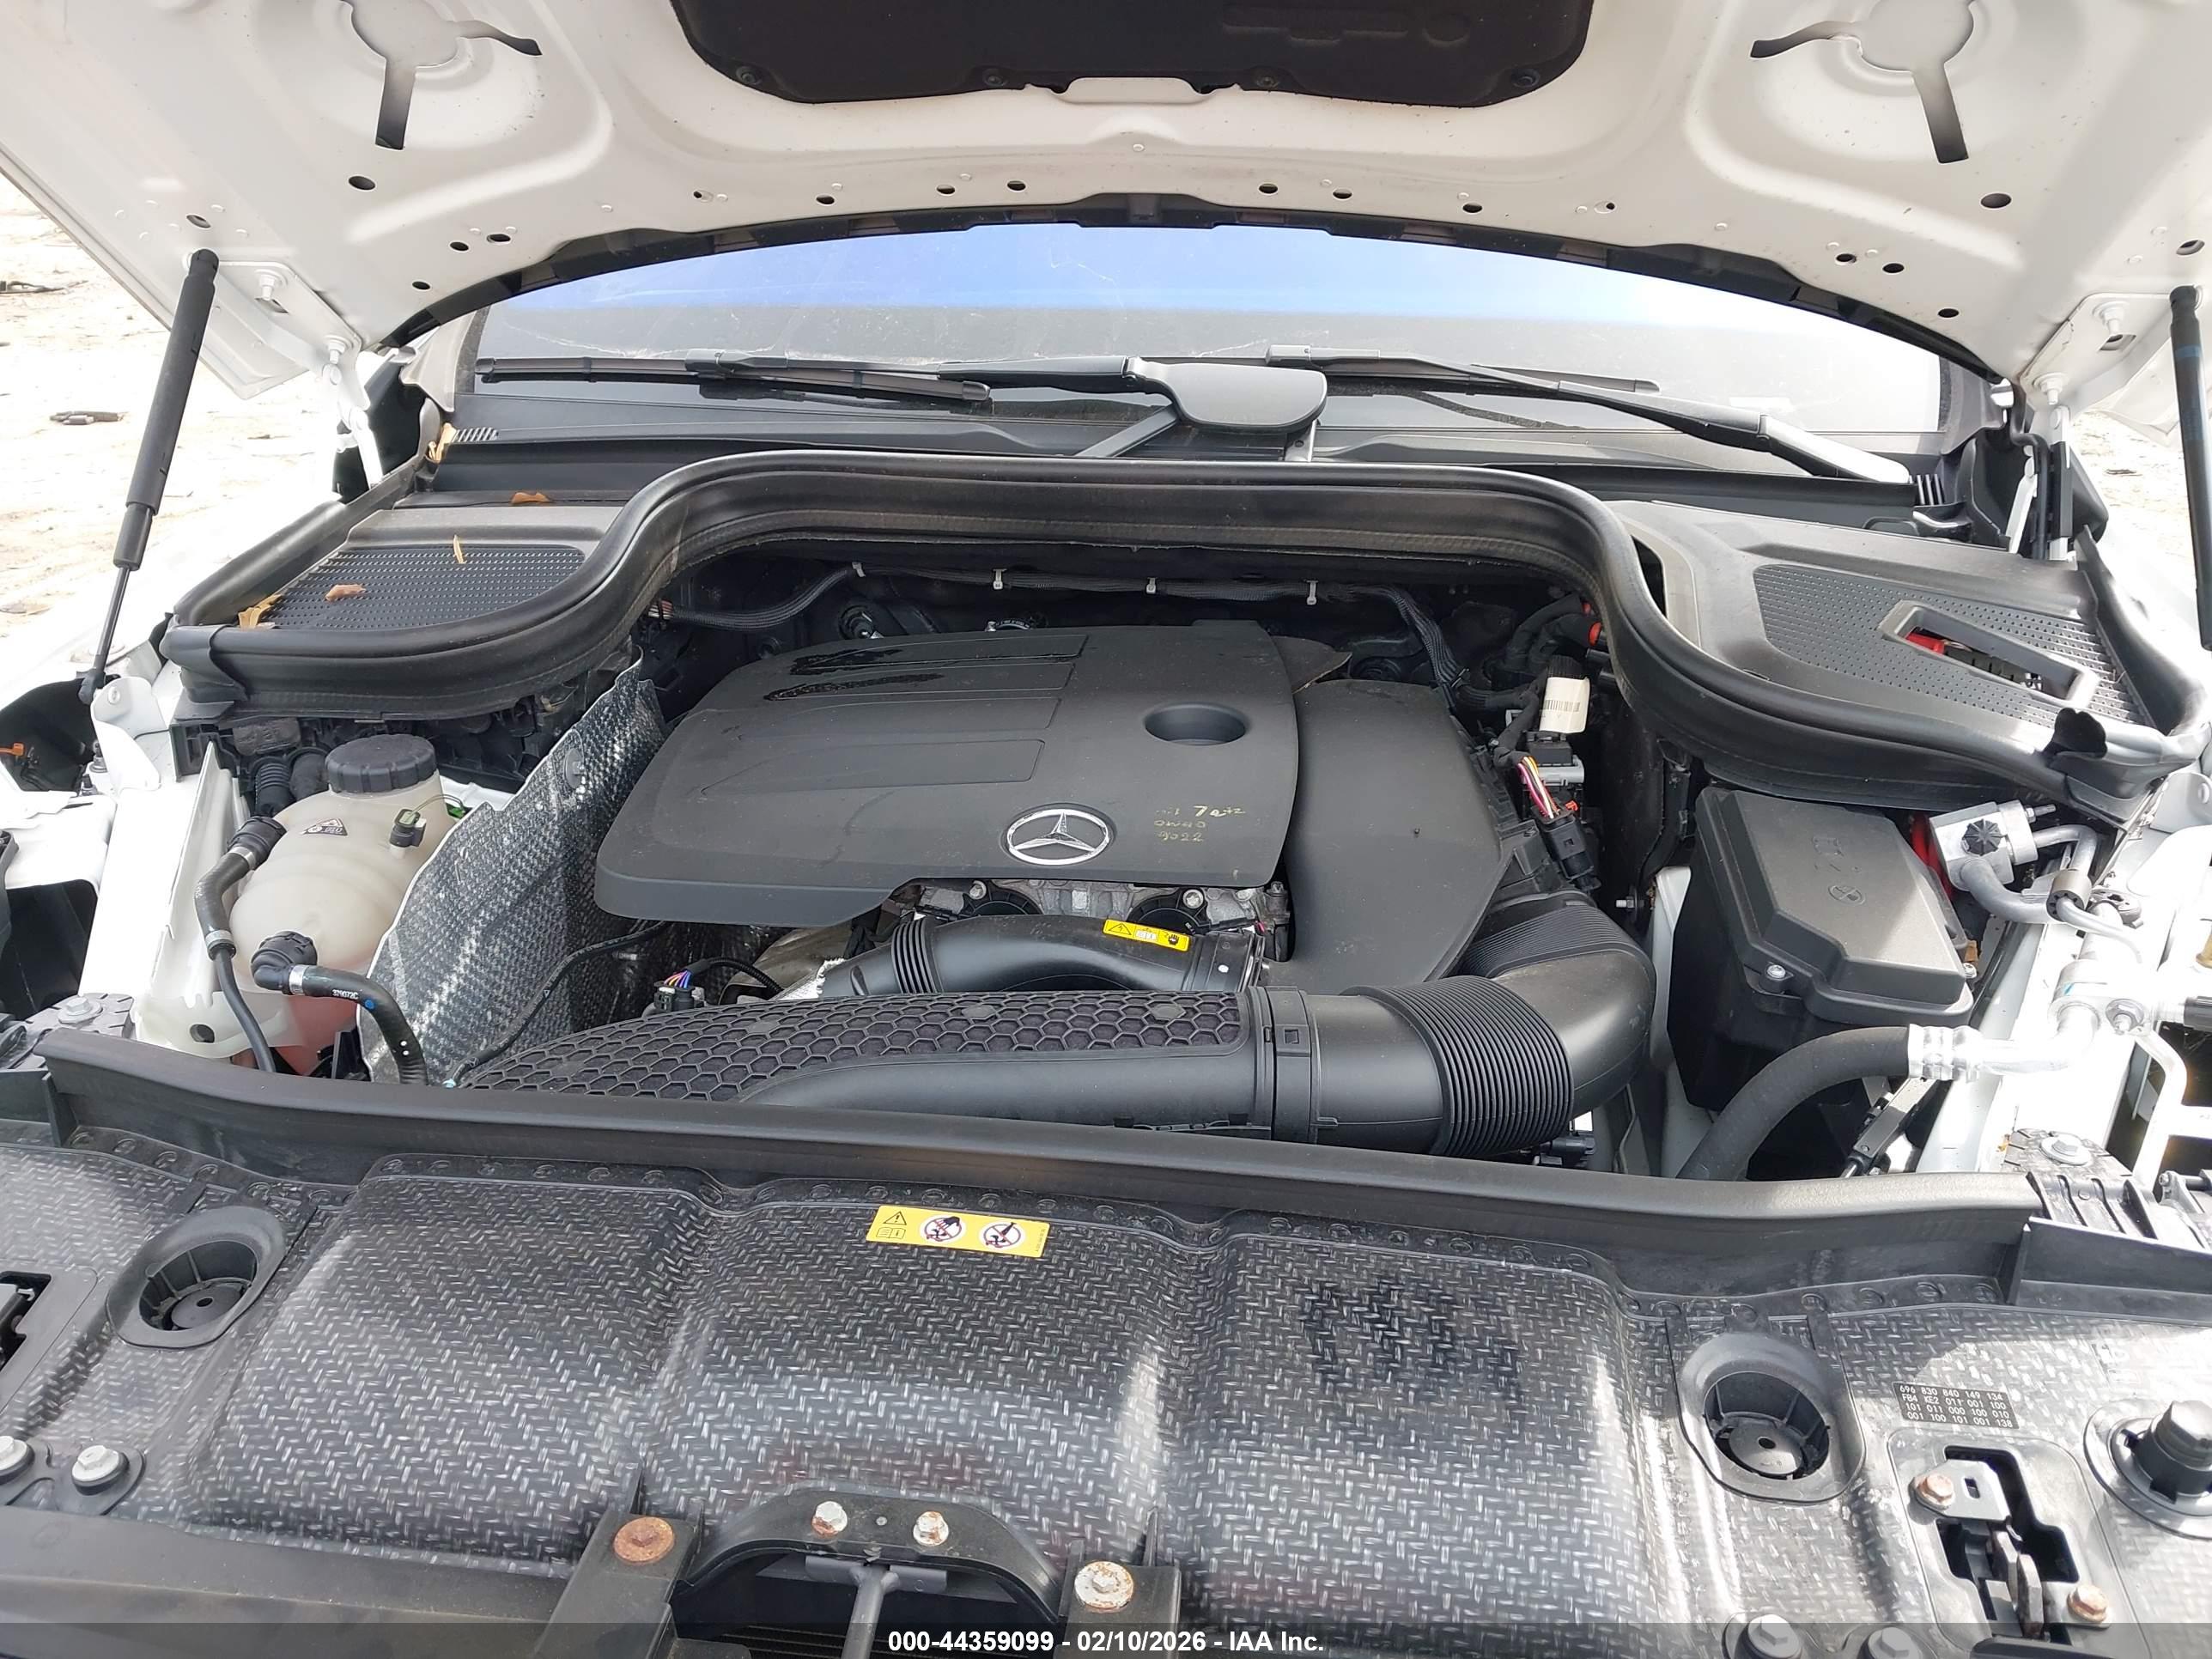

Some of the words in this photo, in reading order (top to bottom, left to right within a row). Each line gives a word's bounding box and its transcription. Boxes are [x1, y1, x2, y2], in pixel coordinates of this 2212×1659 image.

[1899, 1385, 1916, 1394] 696
[1921, 1387, 1937, 1395] 830
[1942, 1389, 1959, 1398] 840
[1965, 1391, 1980, 1400] 149
[1987, 1393, 2002, 1401] 134
[1905, 1402, 1921, 1411] 101
[1927, 1405, 1943, 1413] 011
[1948, 1407, 1965, 1415] 000
[1972, 1408, 1987, 1417] 100
[1992, 1410, 2009, 1419] 010
[1990, 1401, 2006, 1410] 100
[1929, 1413, 1947, 1422] 100
[1952, 1415, 1968, 1424] 101
[1996, 1419, 2013, 1428] 138
